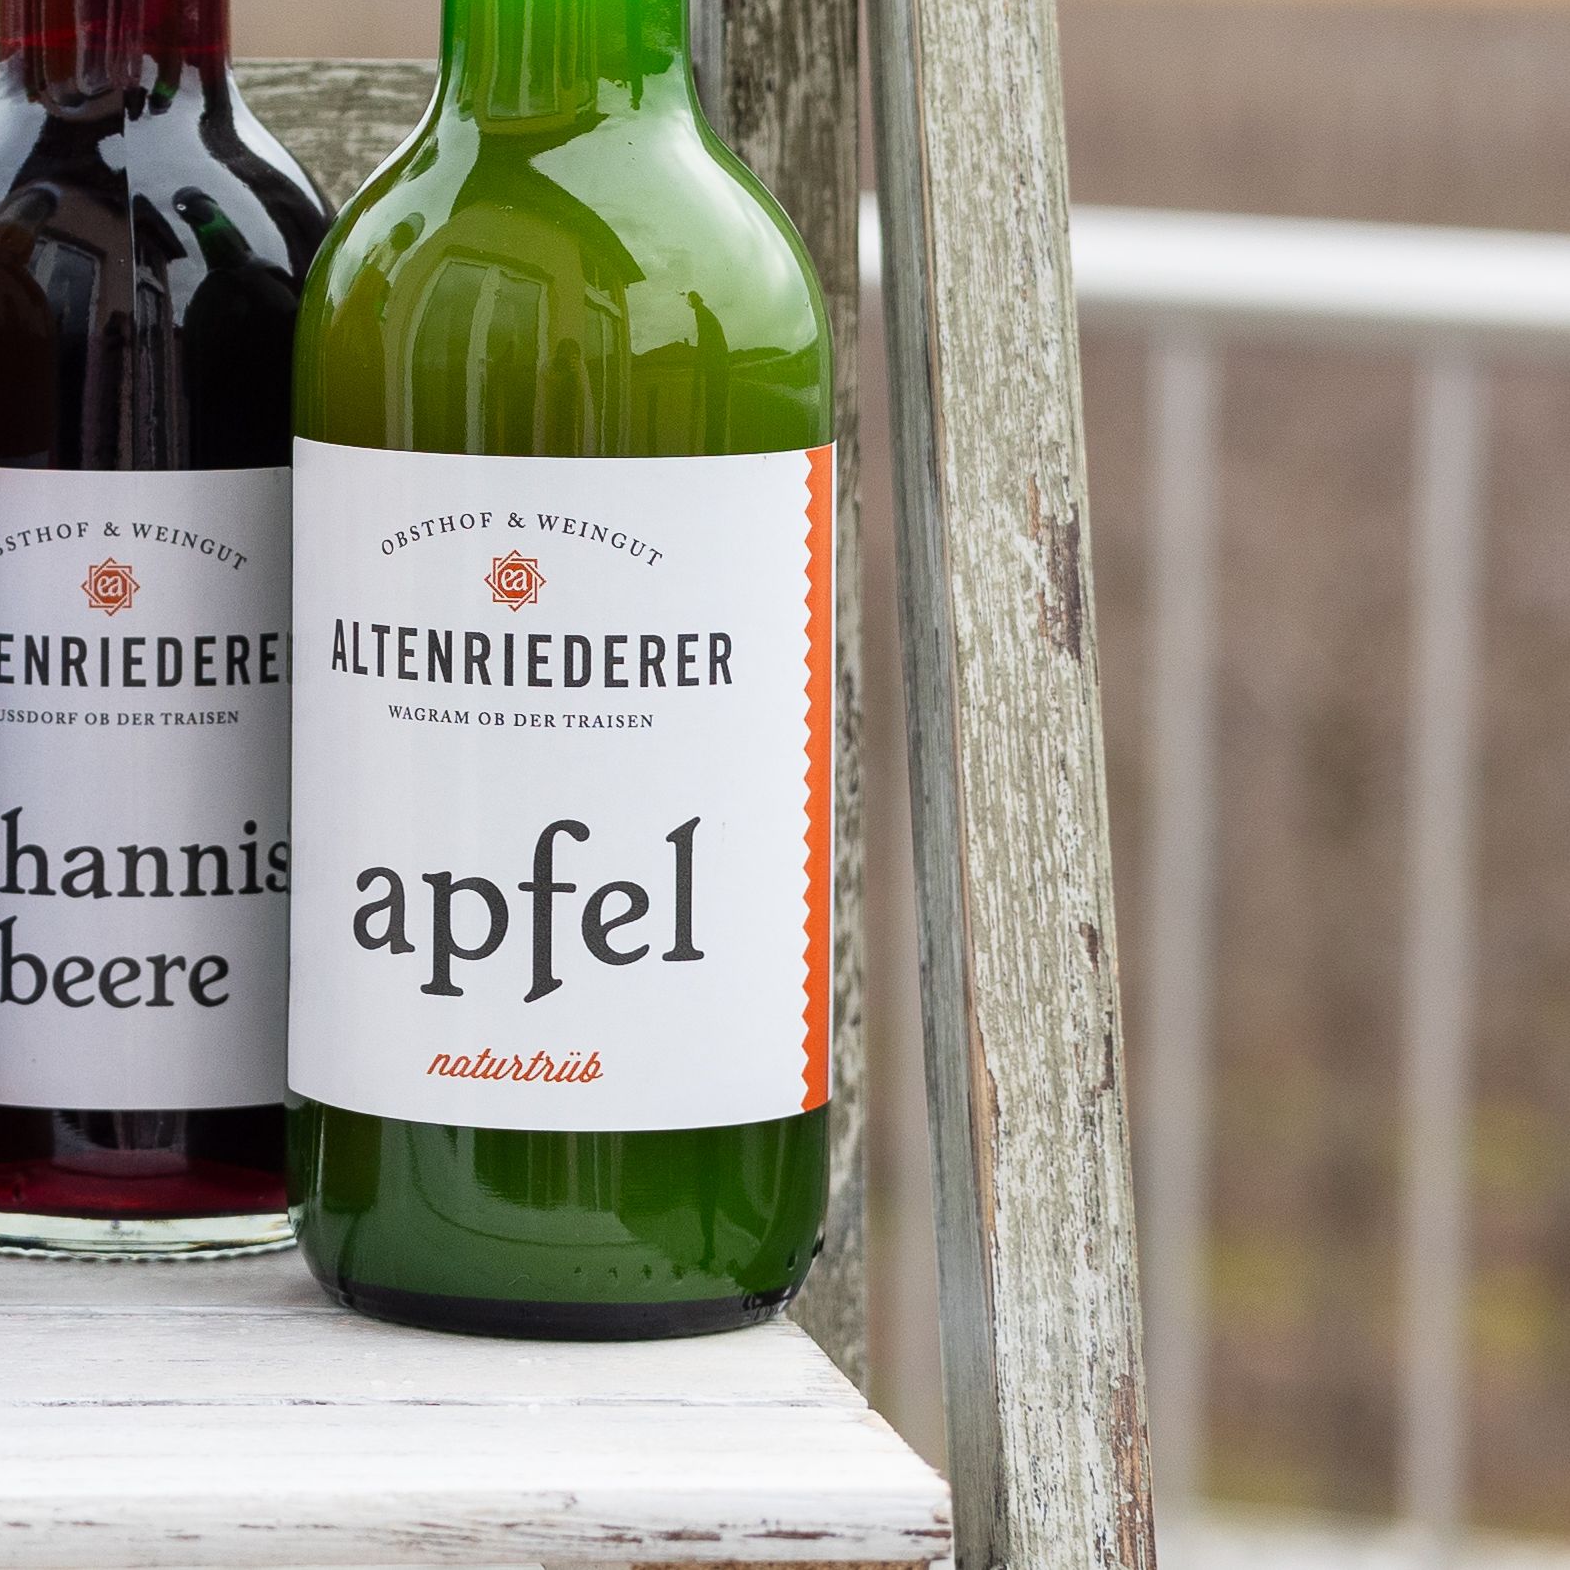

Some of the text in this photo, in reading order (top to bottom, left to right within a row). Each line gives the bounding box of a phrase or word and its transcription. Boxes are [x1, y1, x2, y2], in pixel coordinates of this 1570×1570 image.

[104, 522, 120, 536] &
[129, 523, 247, 573] WEINGUT
[382, 512, 662, 568] OBSTHOF & WEINGUT
[332, 619, 732, 687] ALTENRIEDERER
[85, 713, 109, 725] OB
[118, 713, 154, 725] DER
[160, 711, 238, 725] TRAISEN
[389, 705, 653, 728] WAGRAM OB DER TRAISEN
[353, 817, 704, 1003] apfel
[427, 1049, 603, 1083] naturtrüb
